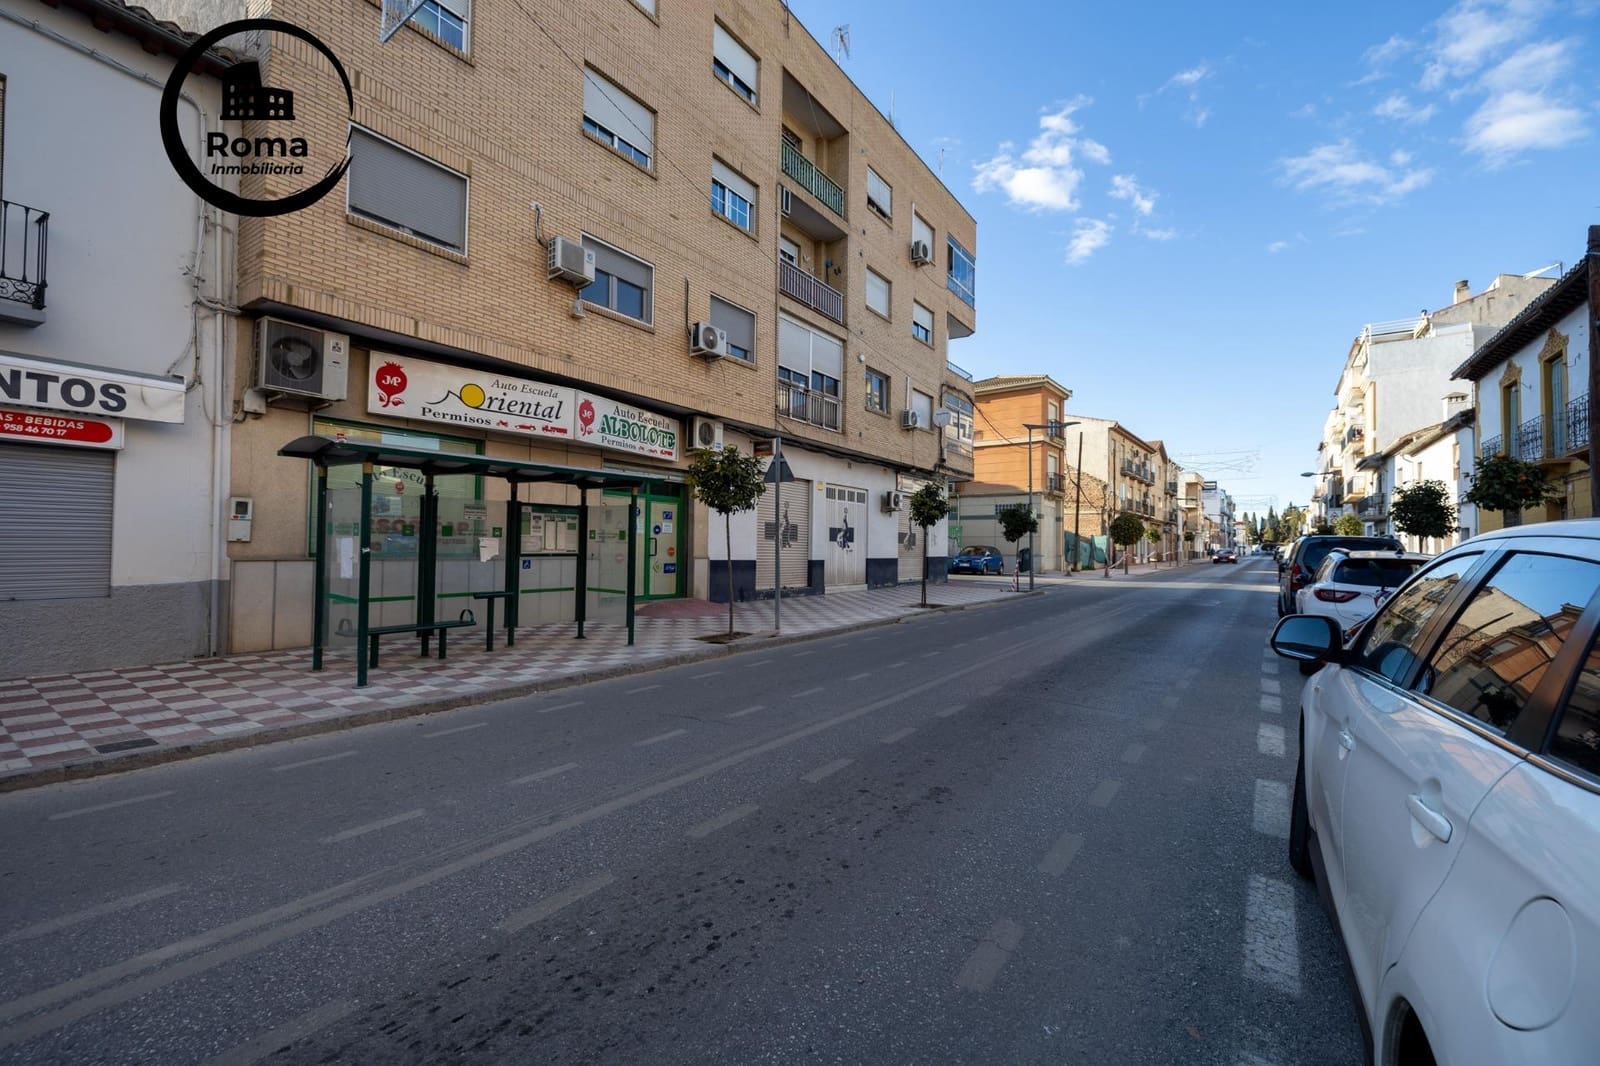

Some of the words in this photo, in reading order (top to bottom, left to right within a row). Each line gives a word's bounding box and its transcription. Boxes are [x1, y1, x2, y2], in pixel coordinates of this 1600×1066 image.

[0, 369, 127, 412] NTOS
[491, 379, 518, 391] Auto
[520, 384, 559, 399] Escuela
[25, 415, 85, 430] BEBIDAS
[421, 406, 492, 426] Permisos
[613, 406, 636, 420] Auto
[638, 411, 670, 430] Escuela
[3, 423, 24, 432] 958
[25, 425, 40, 434] 46
[41, 426, 55, 435] 70
[56, 429, 68, 437] 17
[598, 414, 676, 450] ALBOLOTE
[601, 435, 637, 451] Permisos
